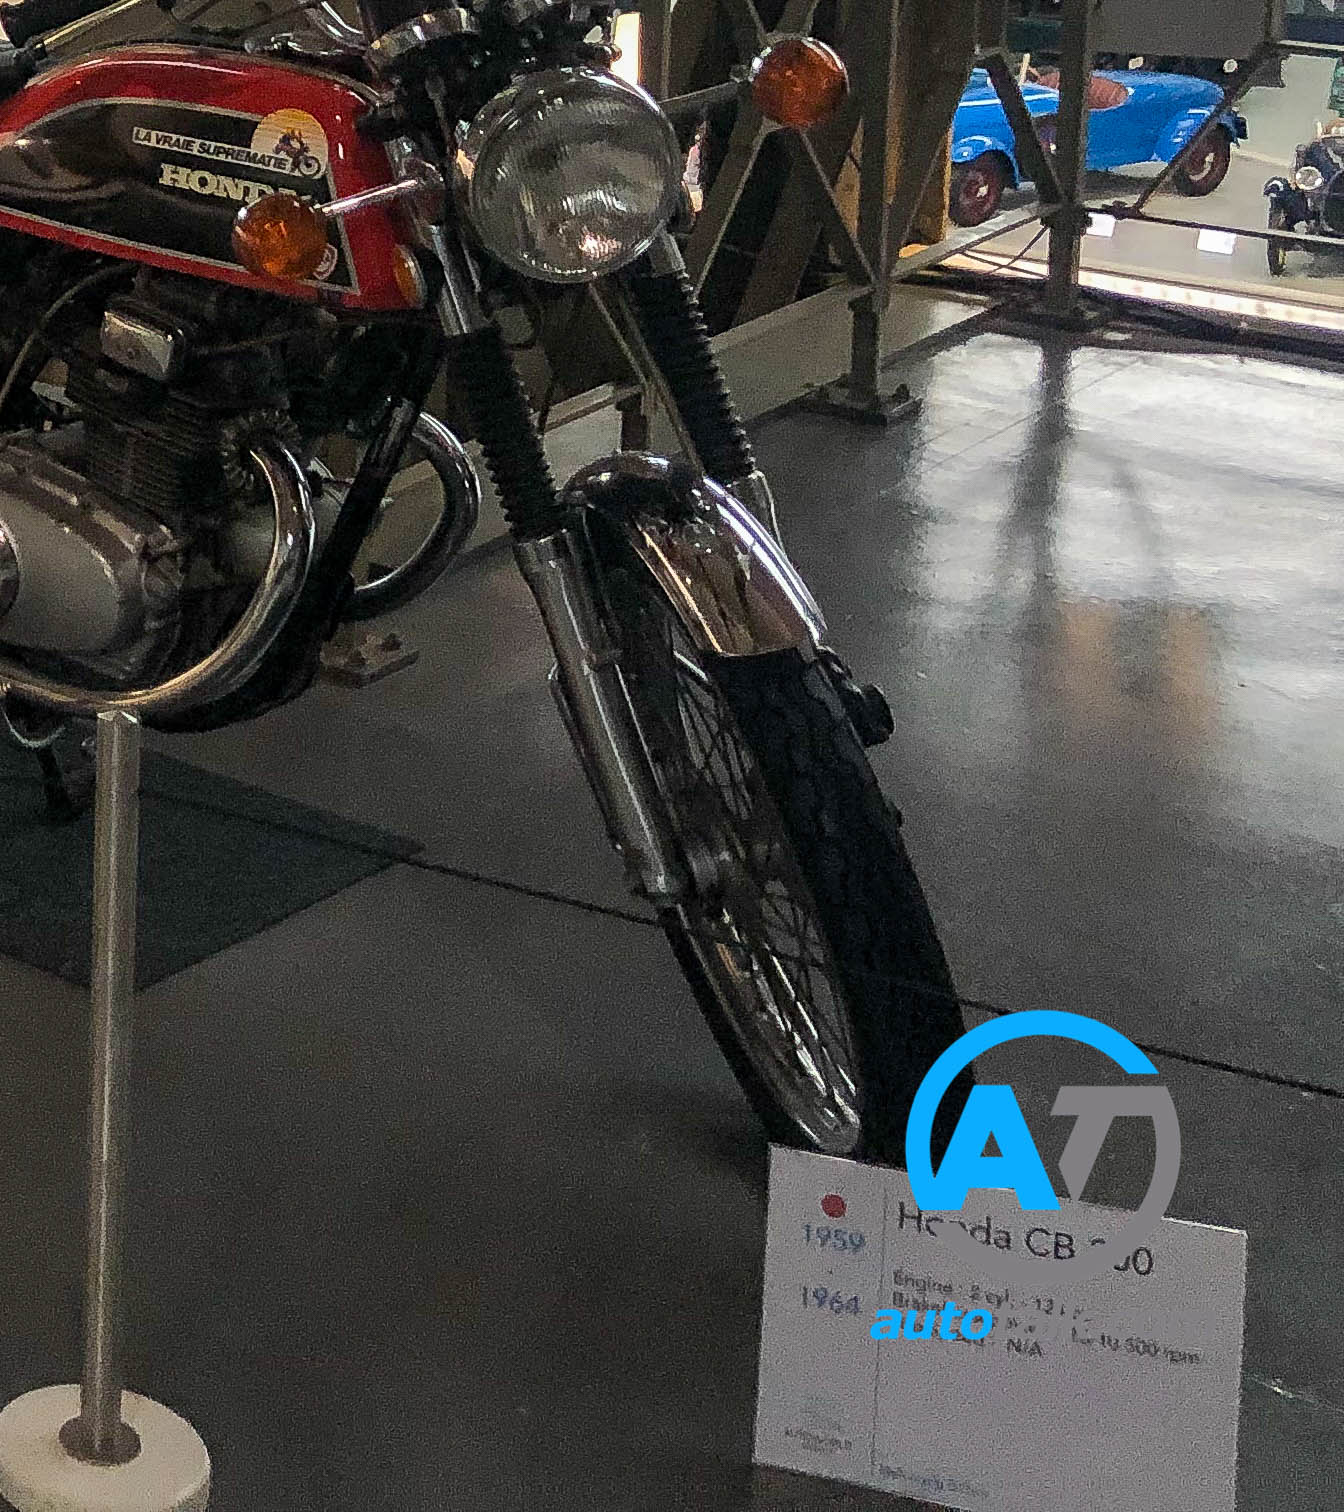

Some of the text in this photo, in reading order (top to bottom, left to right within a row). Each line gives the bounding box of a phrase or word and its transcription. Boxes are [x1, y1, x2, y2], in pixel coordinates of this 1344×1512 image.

[133, 127, 290, 172] LA VRAIE SUPREMATIE
[159, 162, 300, 206] HOND
[803, 1223, 865, 1255] 1959
[897, 1200, 1013, 1252] Hoda
[1023, 1227, 1077, 1260] CB
[801, 1285, 862, 1318] 1964
